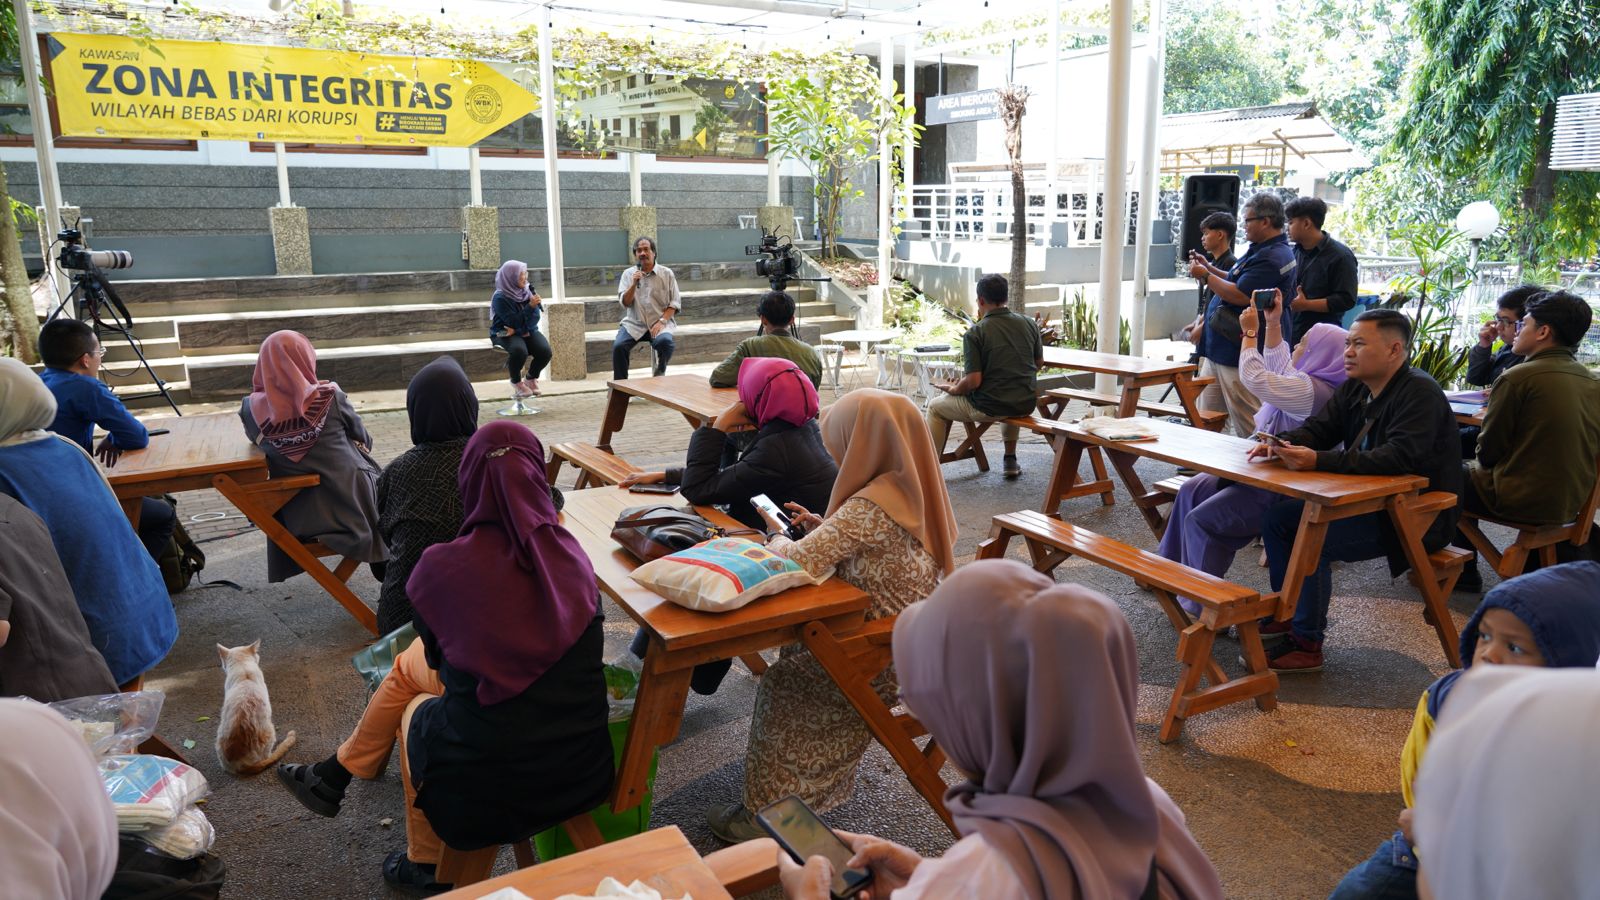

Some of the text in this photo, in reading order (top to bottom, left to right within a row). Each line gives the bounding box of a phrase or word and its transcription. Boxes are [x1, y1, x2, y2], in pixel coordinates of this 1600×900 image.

[79, 48, 140, 61] KAWASAN
[82, 62, 453, 110] ZONA INTEGRITAS
[653, 86, 678, 96] GEOLOGI
[938, 92, 1000, 110] AREA MEROKO
[91, 101, 358, 126] WILAYAH BEBAS DARI KORUPSI
